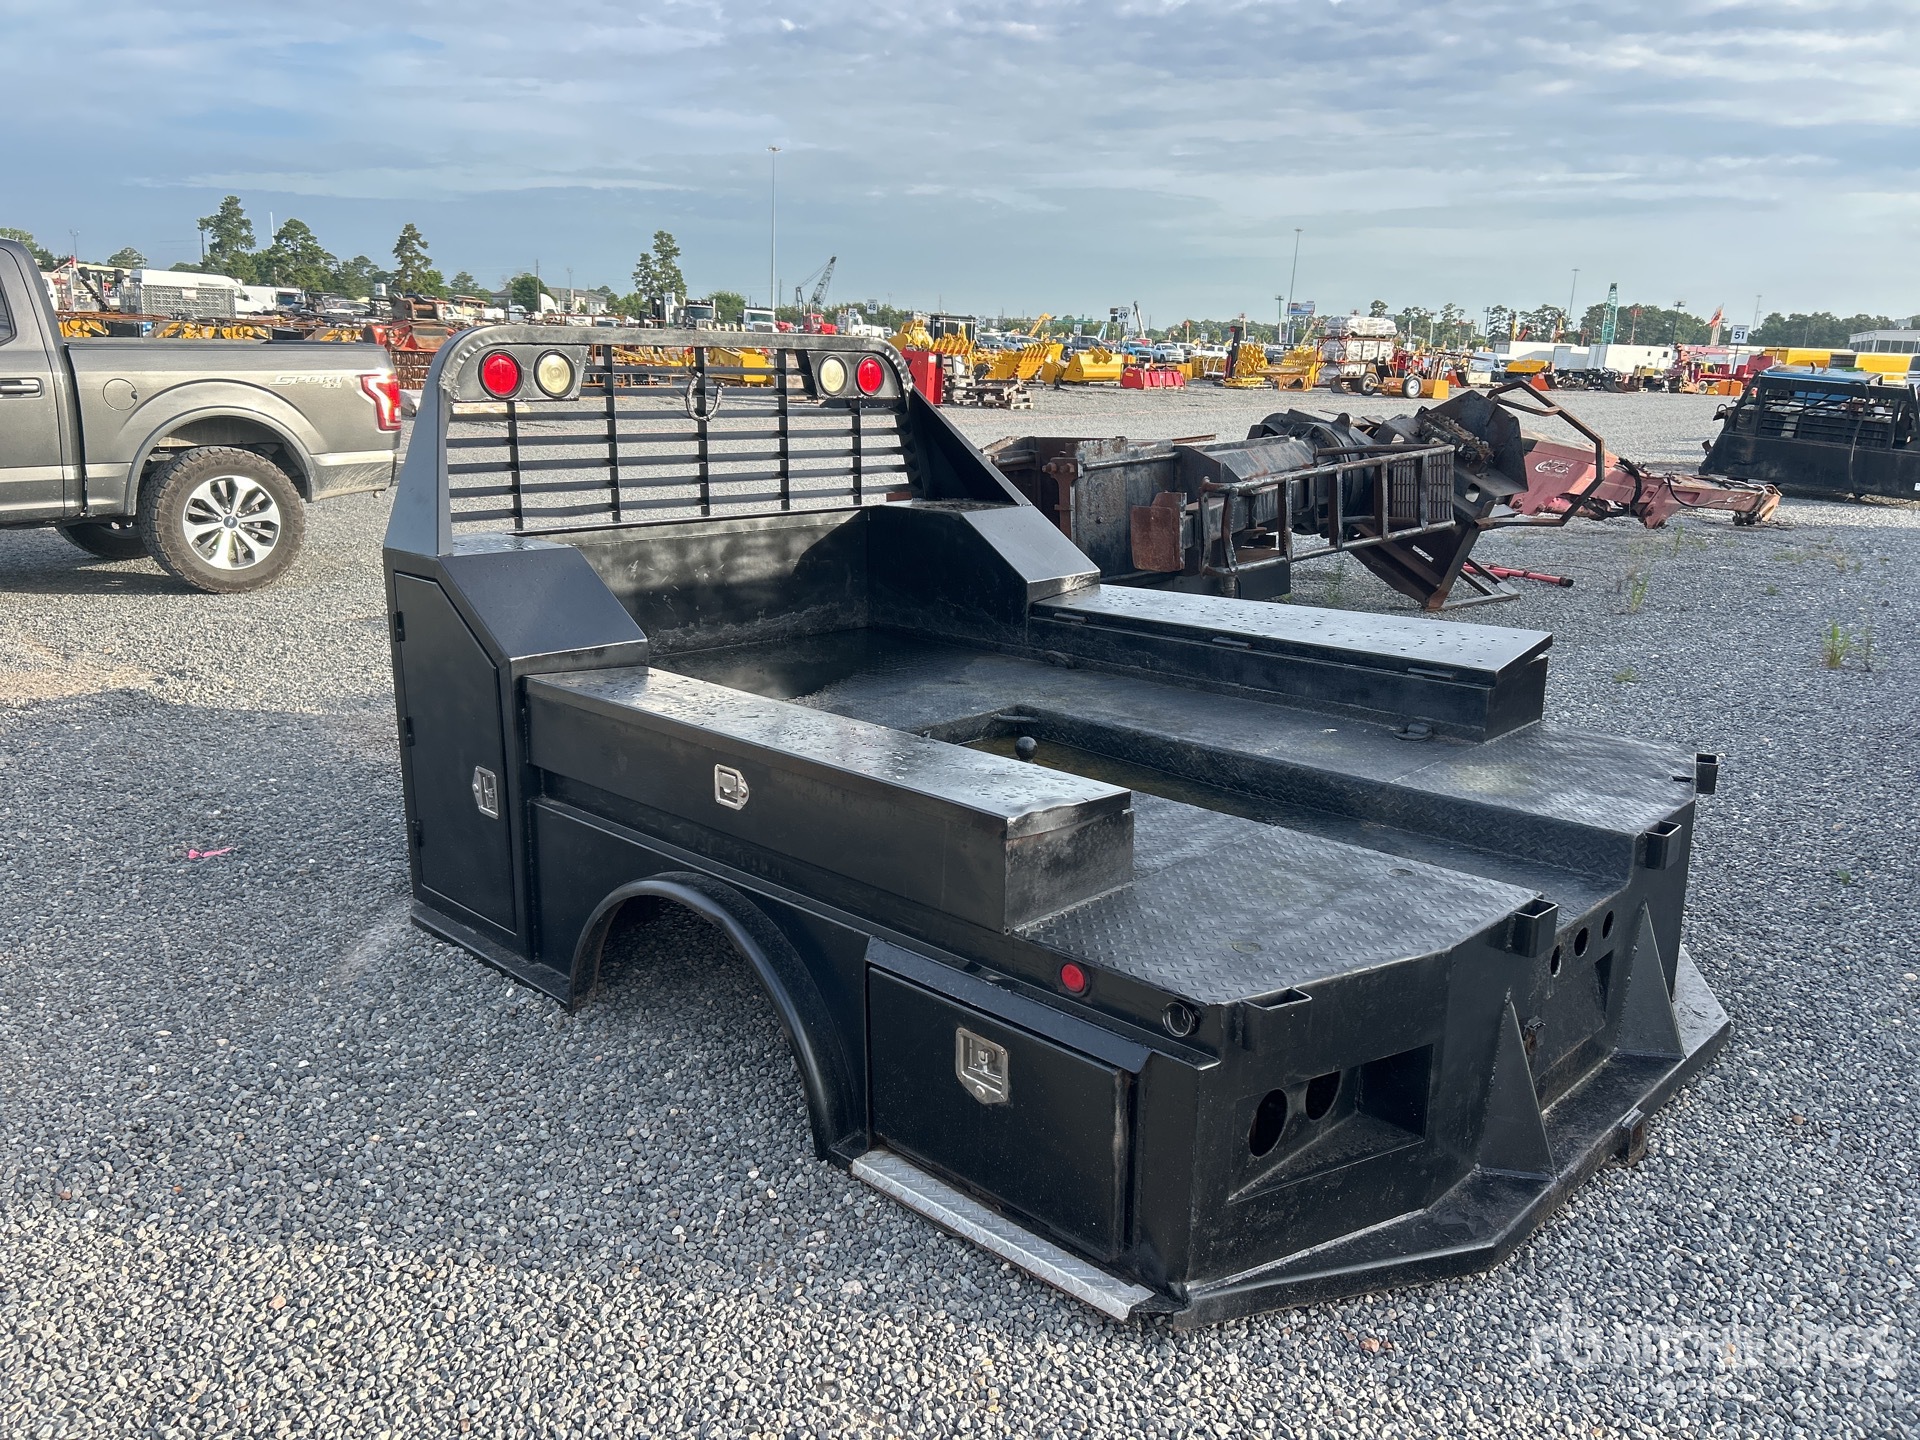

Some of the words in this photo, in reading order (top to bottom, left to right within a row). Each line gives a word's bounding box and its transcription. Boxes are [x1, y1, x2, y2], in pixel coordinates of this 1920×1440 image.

[867, 303, 877, 311] 48
[1118, 311, 1128, 320] 49
[1734, 330, 1745, 340] 51
